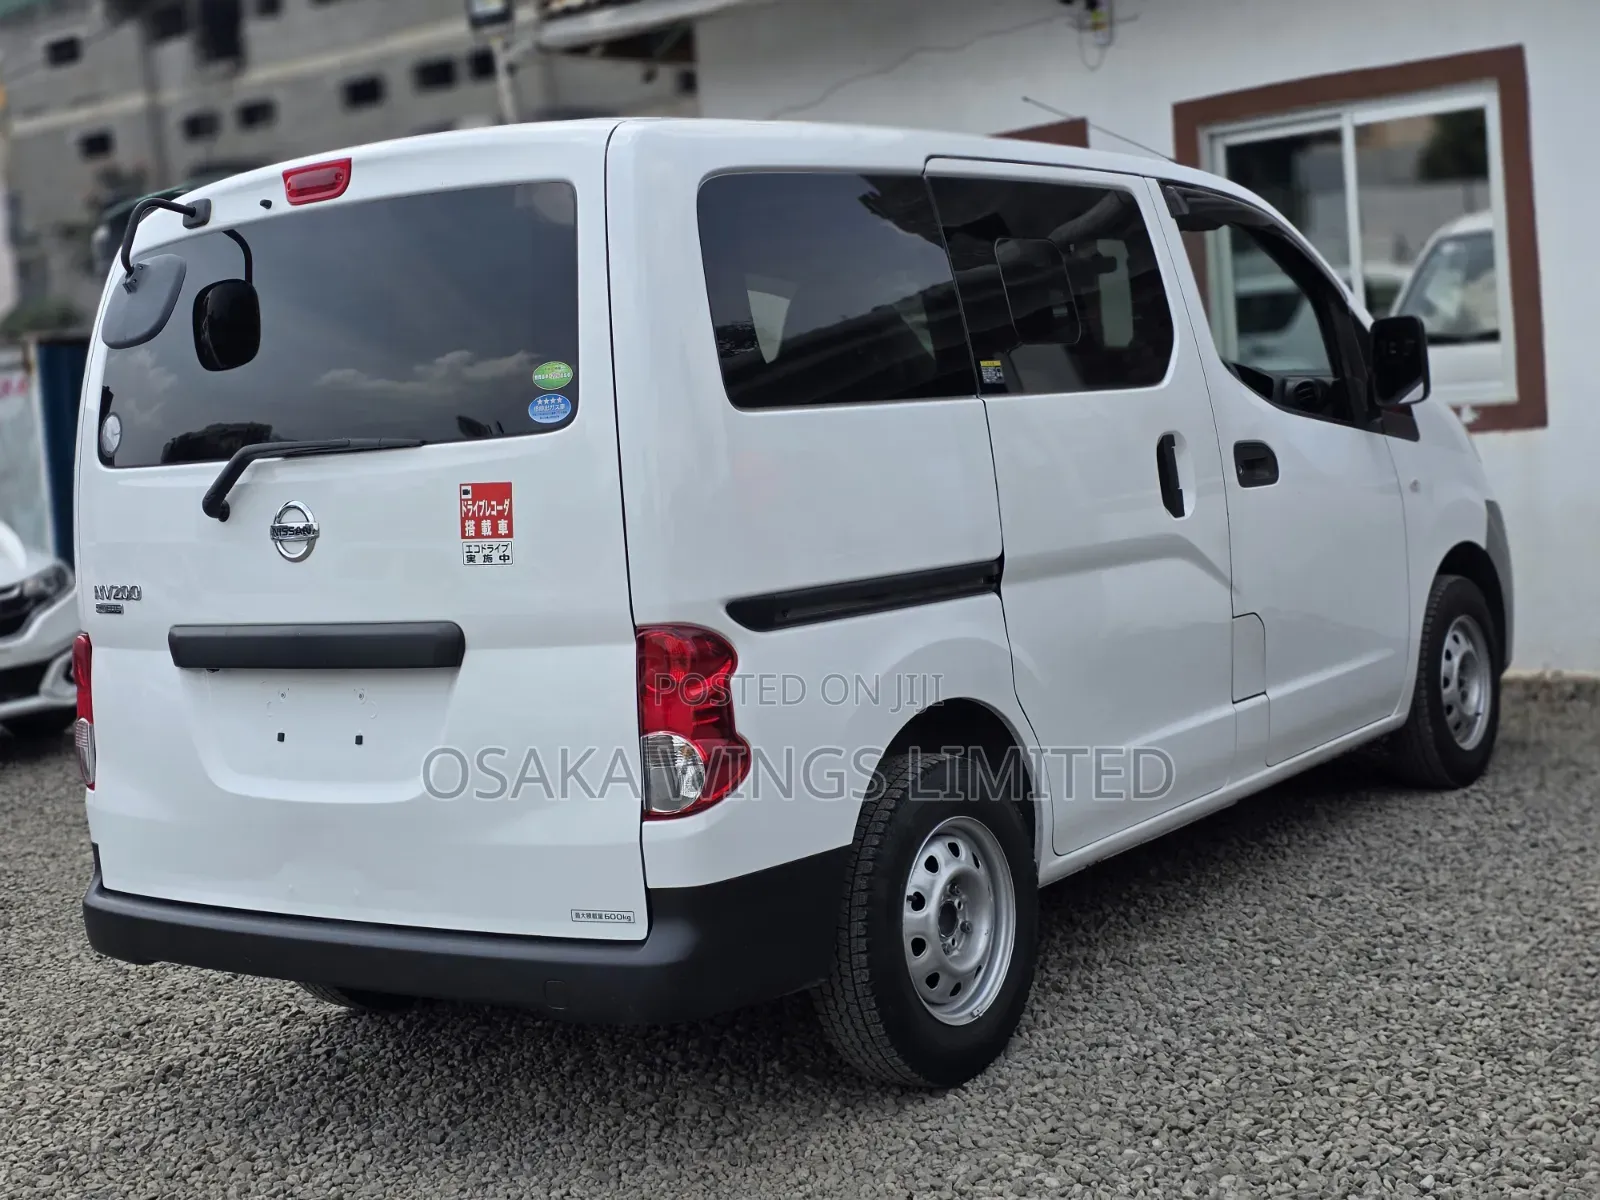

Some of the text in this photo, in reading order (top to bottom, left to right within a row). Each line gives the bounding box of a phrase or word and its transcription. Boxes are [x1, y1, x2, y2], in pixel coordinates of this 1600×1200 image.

[461, 498, 510, 518] ドライブレコーダ
[272, 524, 314, 537] NISSAN
[465, 519, 509, 537] 搭載車
[465, 543, 510, 554] エコドライブ
[466, 553, 510, 563] 実施中
[94, 585, 142, 601] NV200
